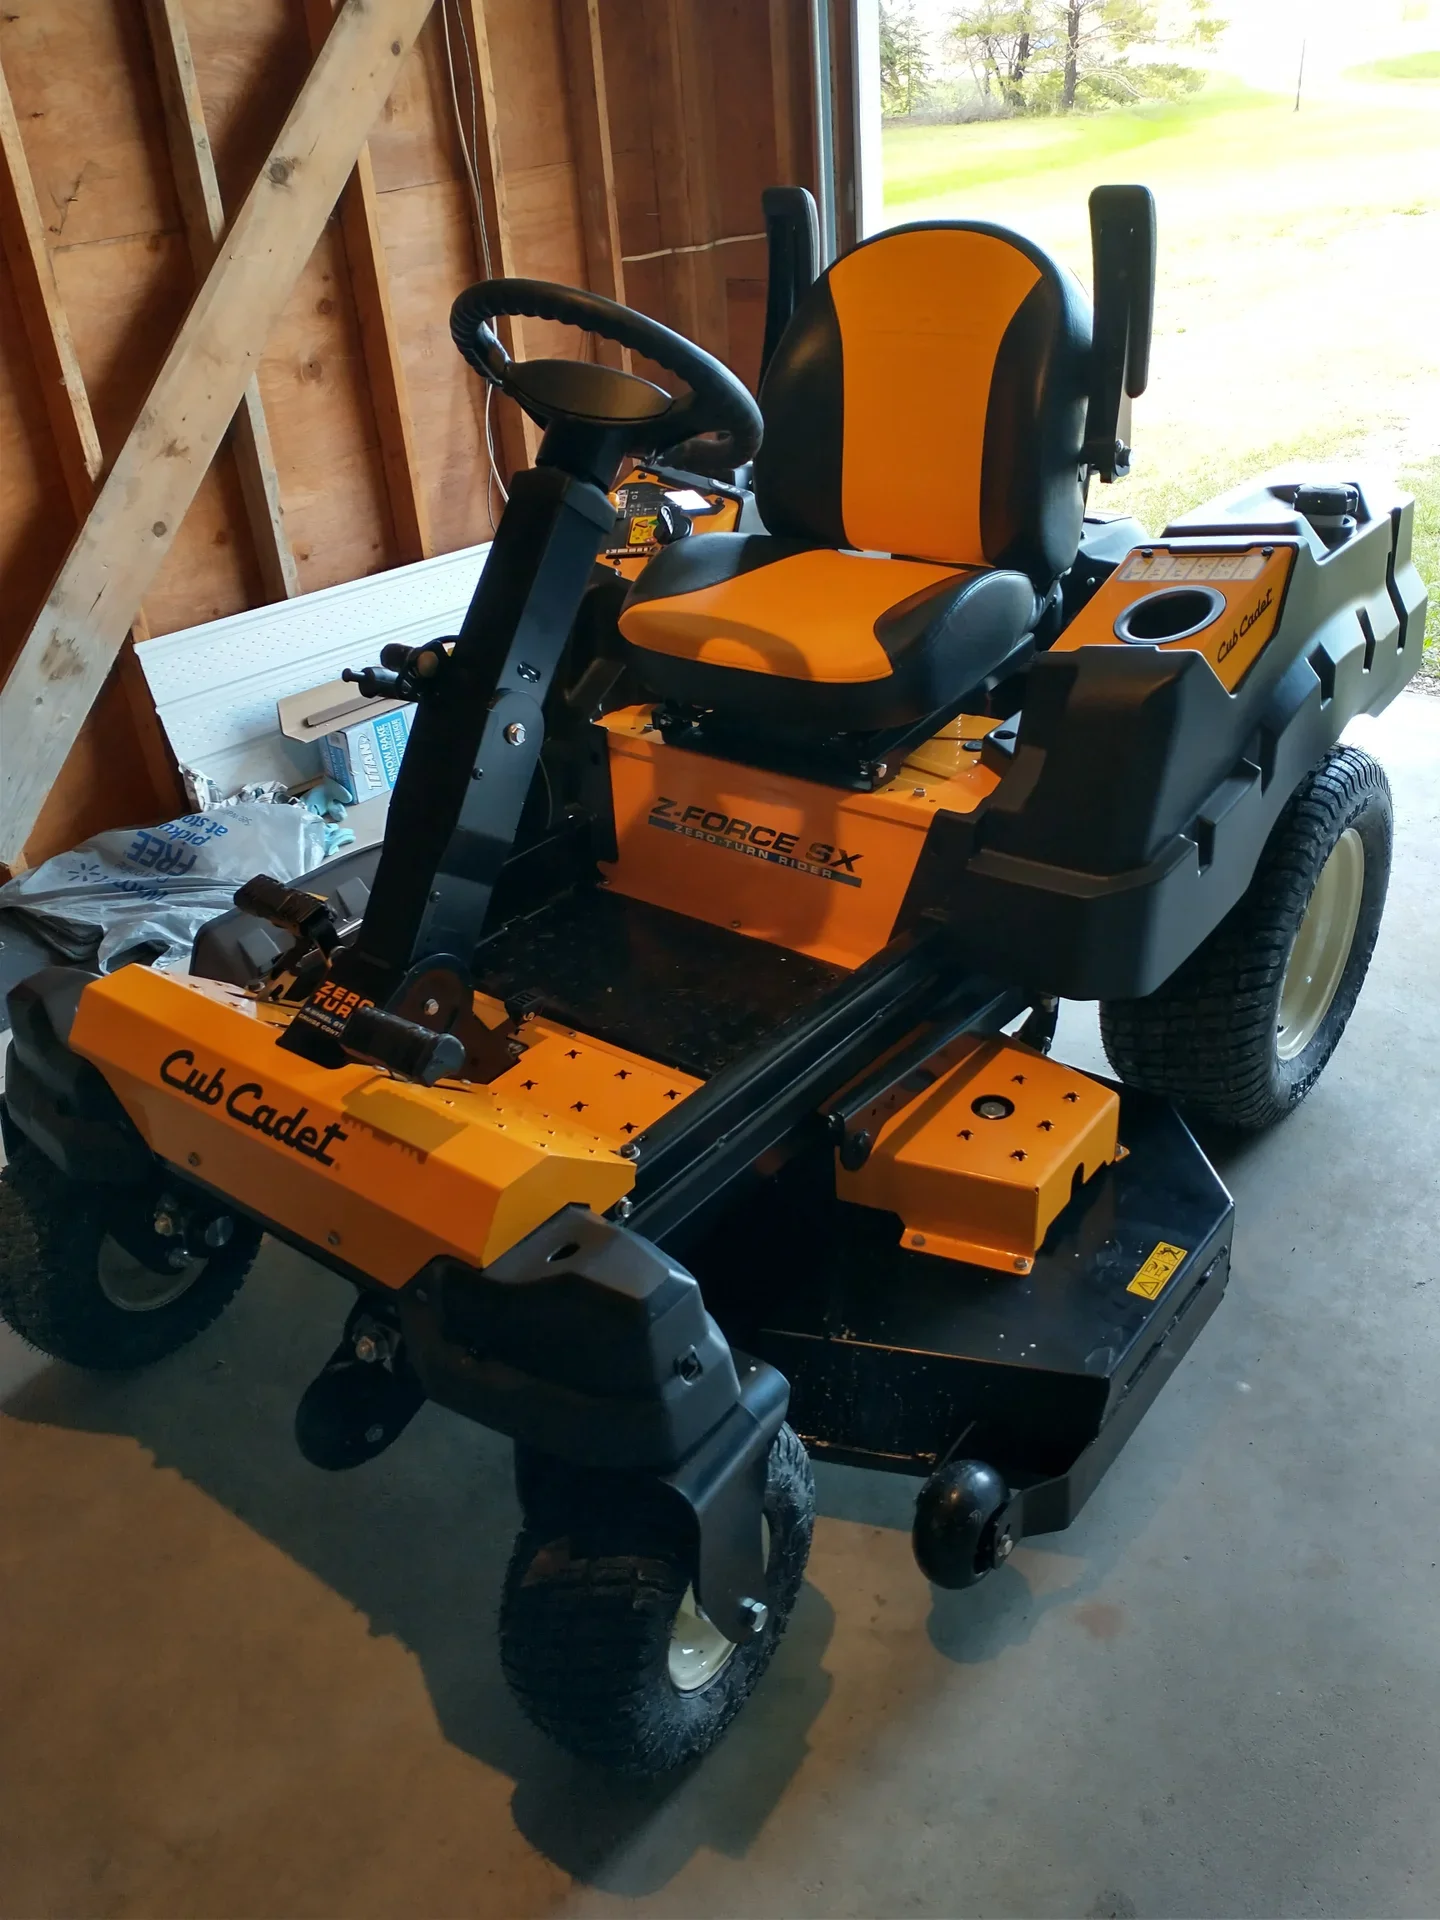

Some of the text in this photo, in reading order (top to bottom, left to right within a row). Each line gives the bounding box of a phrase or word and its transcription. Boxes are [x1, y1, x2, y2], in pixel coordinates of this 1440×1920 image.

[1217, 588, 1273, 664] Cub Cadet
[375, 724, 391, 751] RAKE
[359, 743, 382, 790] TITAN
[382, 751, 398, 782] SNOW
[159, 823, 211, 848] picku
[181, 815, 229, 837] at sto
[651, 796, 864, 873] Z-FORCE SX
[126, 830, 198, 877] FREE
[778, 855, 833, 879] RIDER
[313, 991, 353, 1019] TUR
[320, 1024, 341, 1038] CONT
[160, 1049, 349, 1167] Cub Cadet
